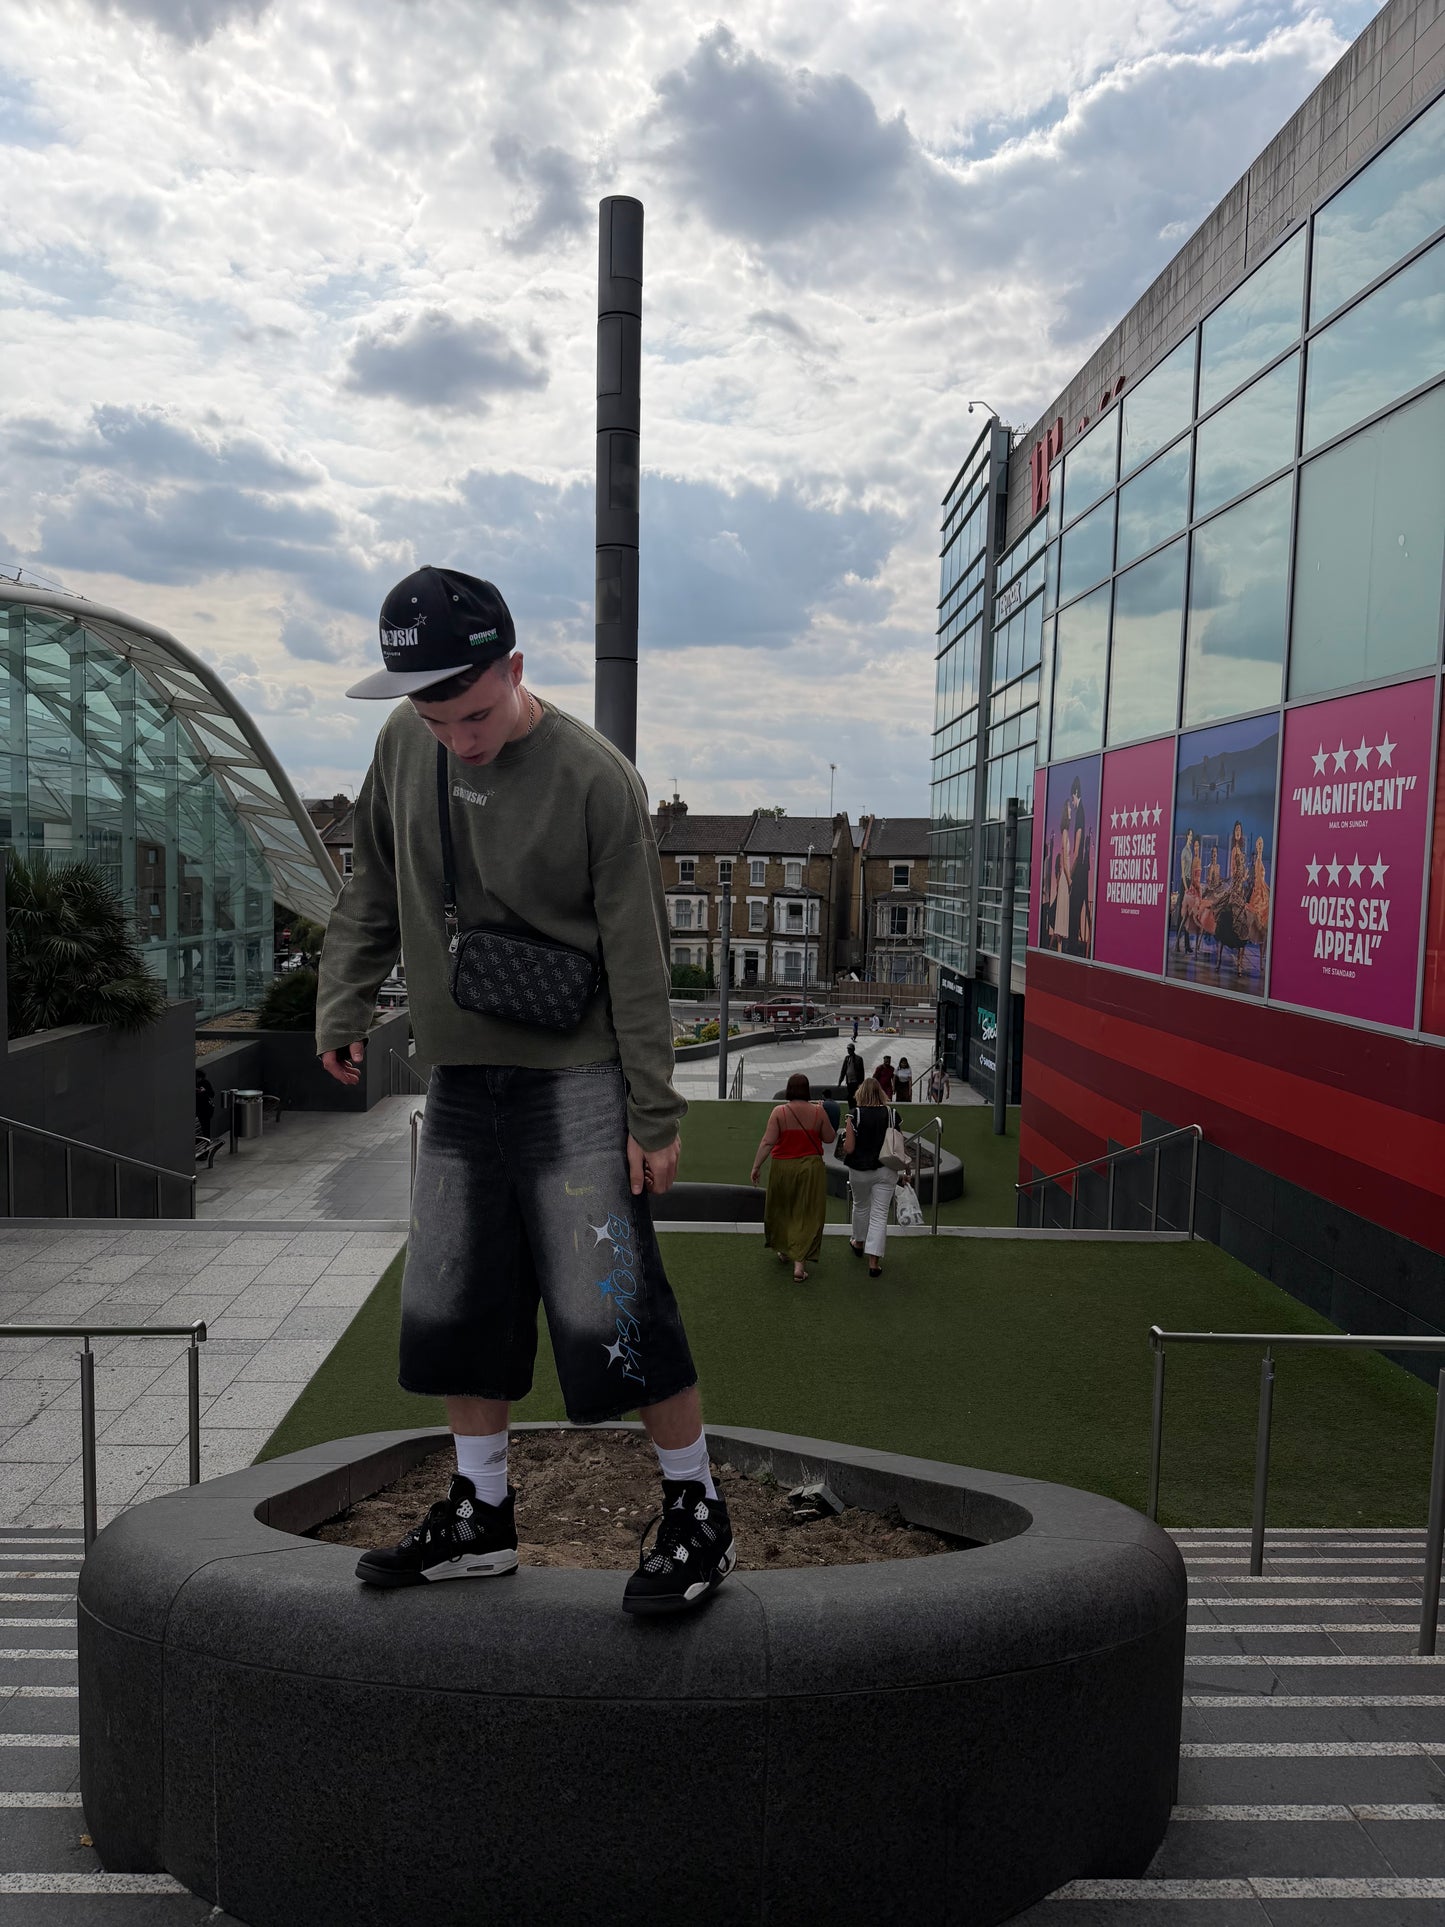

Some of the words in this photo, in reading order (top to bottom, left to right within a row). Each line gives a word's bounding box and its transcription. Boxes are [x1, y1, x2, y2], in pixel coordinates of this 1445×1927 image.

[1293, 775, 1417, 816] "MAGNIFICENT"
[1329, 821, 1340, 829] MAIL
[1341, 821, 1348, 829] ON
[1349, 820, 1368, 829] SUNDAY
[1110, 834, 1131, 857] "THIS
[1131, 832, 1157, 856] STAGE
[1110, 858, 1141, 880] VERSION
[1142, 858, 1151, 880] IS
[1152, 858, 1158, 881] A
[1106, 882, 1164, 906] PHENOMENON"
[1301, 895, 1355, 928] "OOZES
[1358, 898, 1390, 932] SEX
[1313, 929, 1382, 966] APPEAL"
[1323, 967, 1331, 975] THE
[1331, 968, 1356, 978] STANDARD
[608, 1212, 646, 1387] BROVSKI
